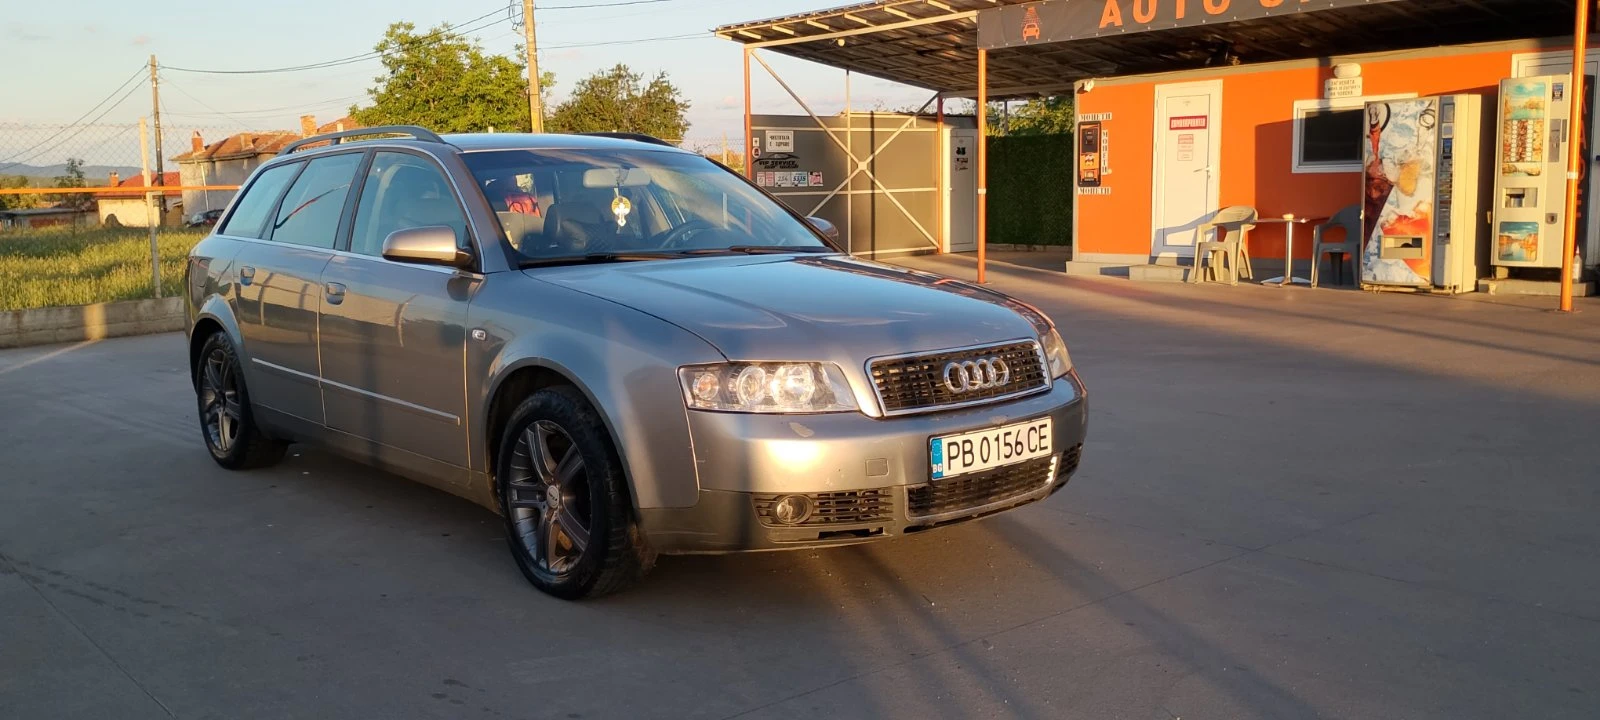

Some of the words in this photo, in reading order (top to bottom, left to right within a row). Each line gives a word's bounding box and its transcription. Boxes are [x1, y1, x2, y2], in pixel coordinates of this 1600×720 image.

[947, 439, 975, 470] PB
[980, 430, 1024, 464] 0156
[1028, 424, 1048, 453] CE
[932, 463, 943, 474] BG
